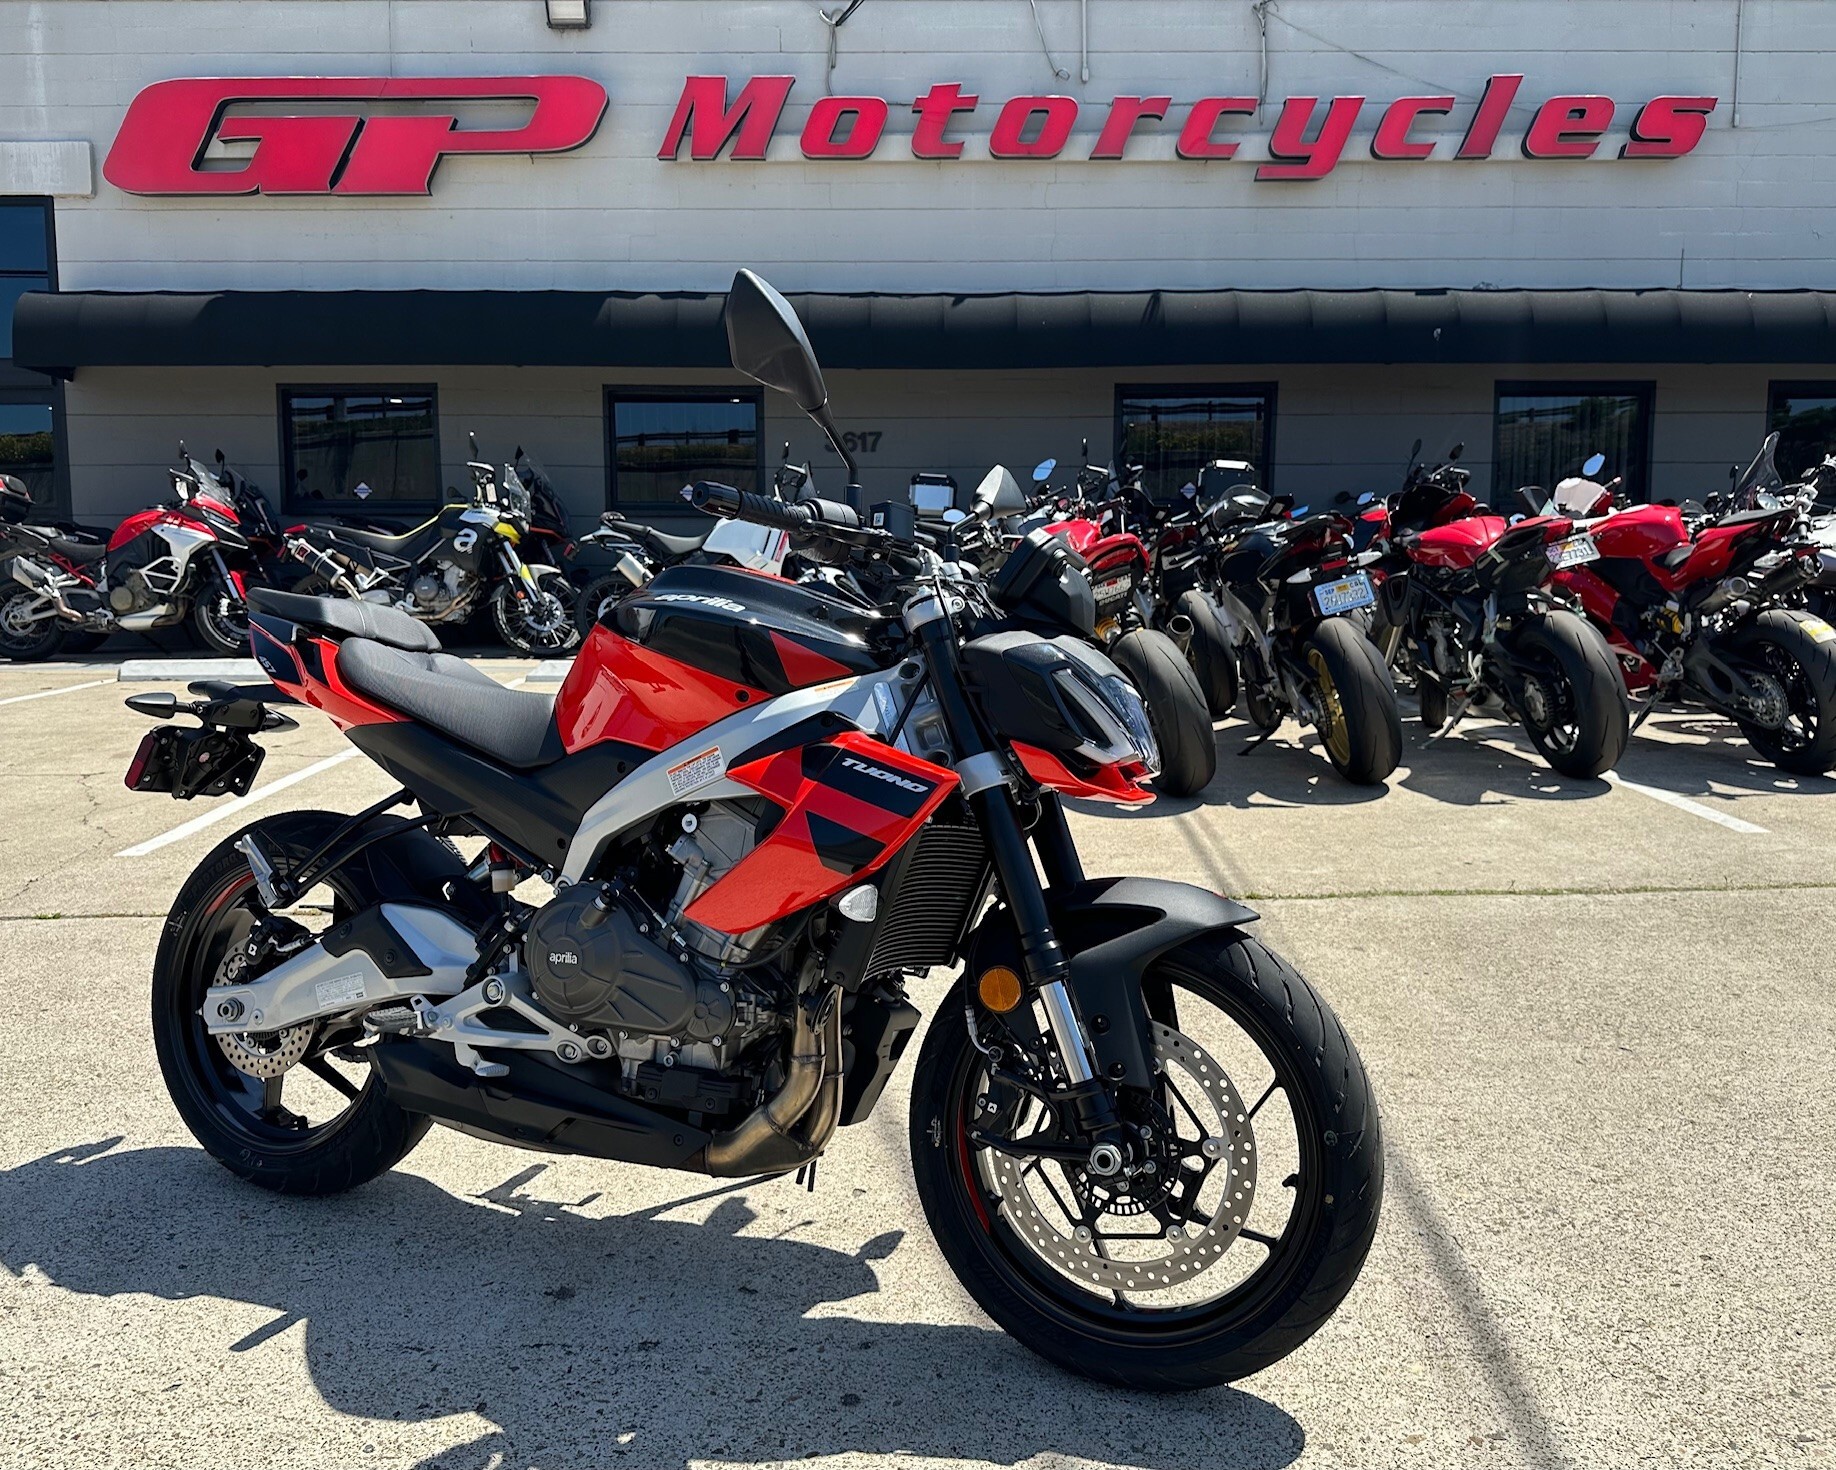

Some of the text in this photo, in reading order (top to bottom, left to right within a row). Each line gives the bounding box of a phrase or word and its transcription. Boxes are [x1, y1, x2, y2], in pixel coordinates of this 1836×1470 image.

[103, 72, 1717, 196] GP Motorcycles
[654, 594, 746, 613] aprilia
[258, 655, 277, 673] 457
[842, 757, 928, 792] TUONO
[549, 951, 578, 965] aprilia
